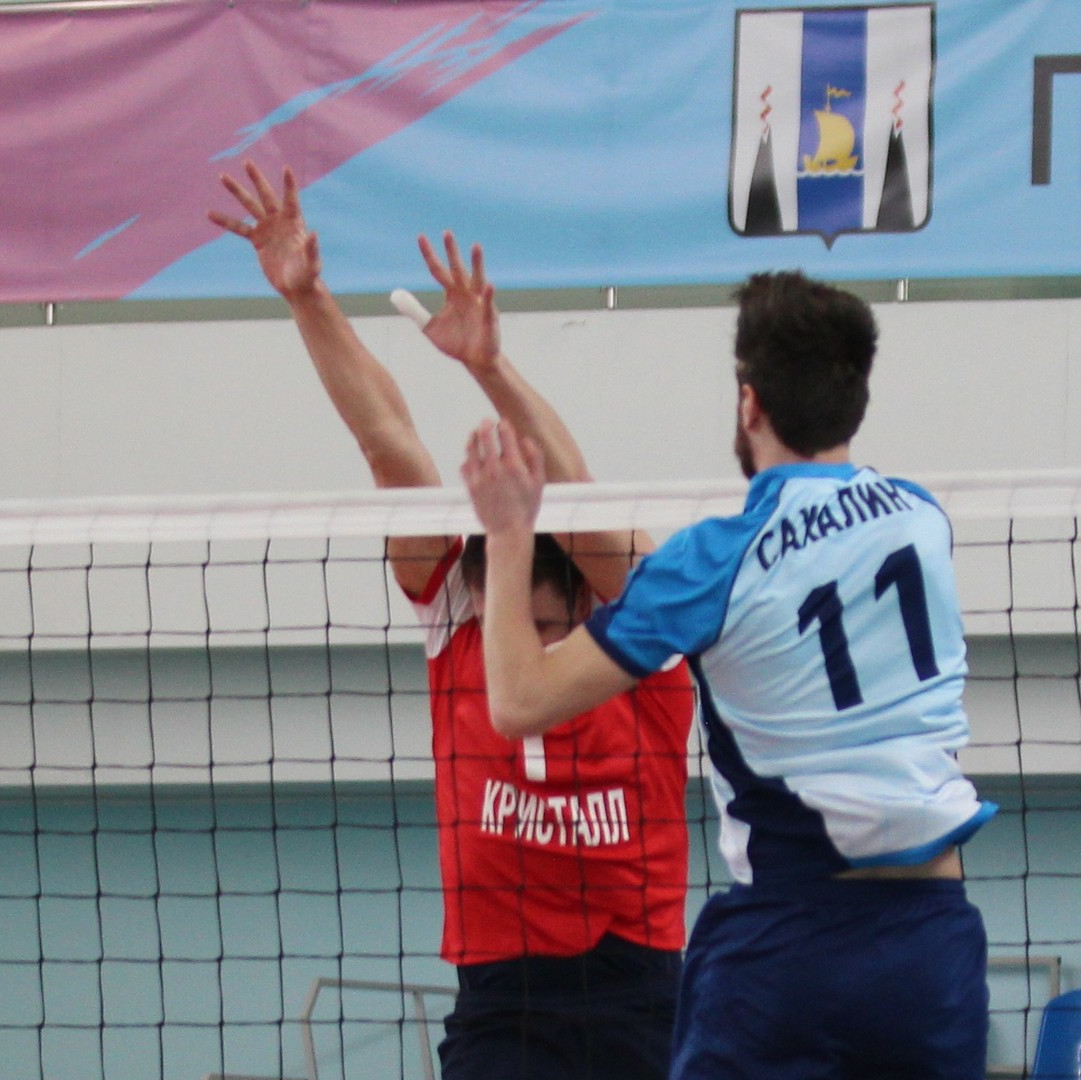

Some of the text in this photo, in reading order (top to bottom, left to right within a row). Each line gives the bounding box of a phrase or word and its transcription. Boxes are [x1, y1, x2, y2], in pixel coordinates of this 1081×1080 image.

[756, 480, 914, 572] САХАЛИН
[798, 542, 941, 712] 11
[480, 778, 630, 848] КРИСТАЛЛ
